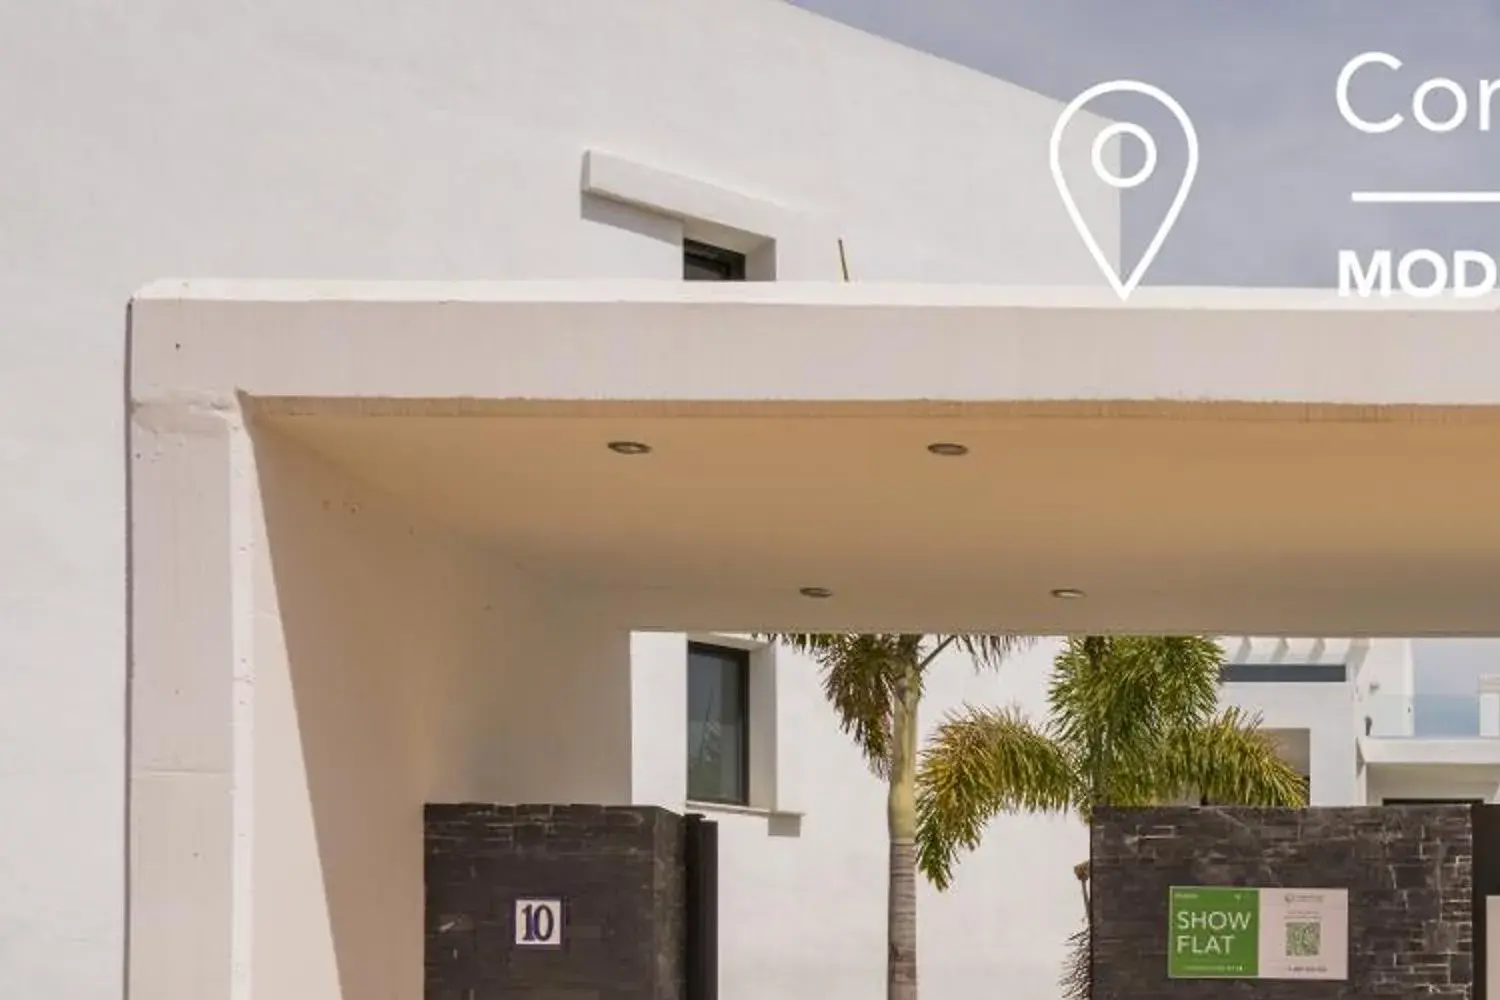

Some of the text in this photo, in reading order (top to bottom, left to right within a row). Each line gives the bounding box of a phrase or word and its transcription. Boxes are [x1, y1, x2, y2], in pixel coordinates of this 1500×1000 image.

[521, 903, 555, 942] 10
[1176, 911, 1251, 930] SHOW
[1176, 934, 1235, 954] FLAT
